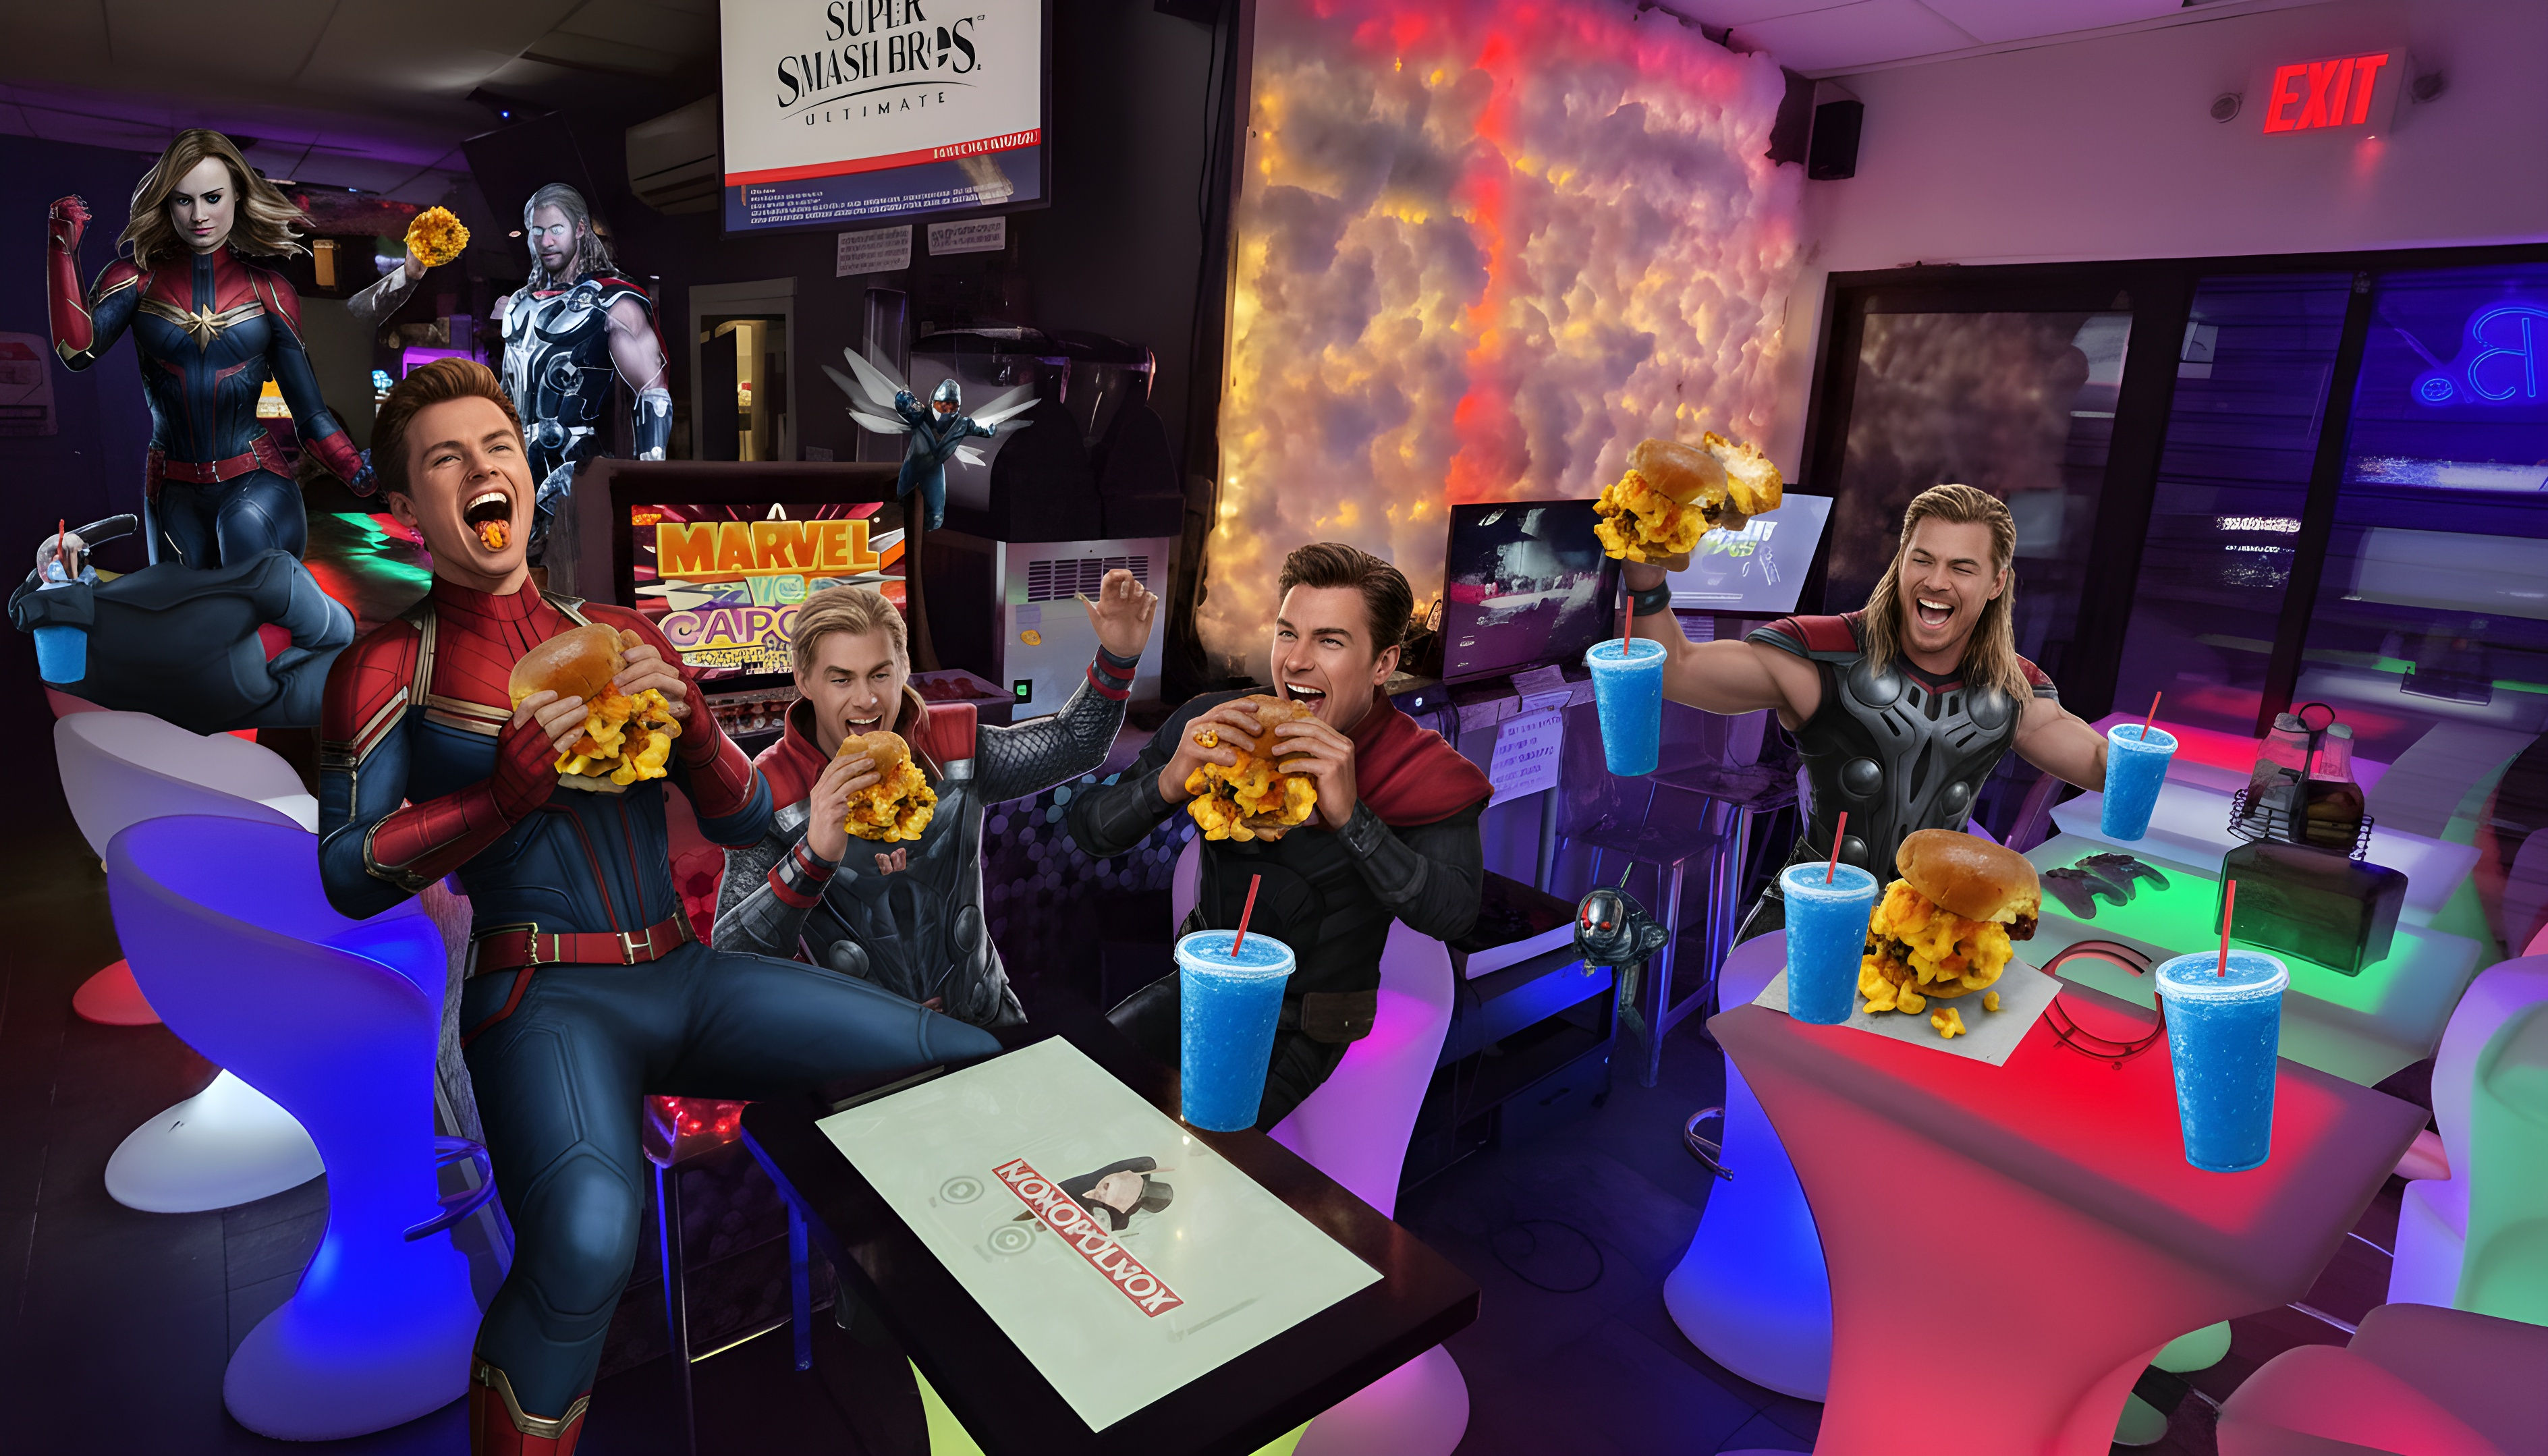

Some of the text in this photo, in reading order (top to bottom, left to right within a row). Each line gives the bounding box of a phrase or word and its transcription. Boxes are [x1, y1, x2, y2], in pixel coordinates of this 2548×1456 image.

[826, 0, 926, 40] SUPER
[777, 40, 878, 108] SMASH
[2263, 53, 2389, 134] EXIT
[806, 91, 945, 125] ULTIMATE
[657, 520, 880, 576] MARVEL
